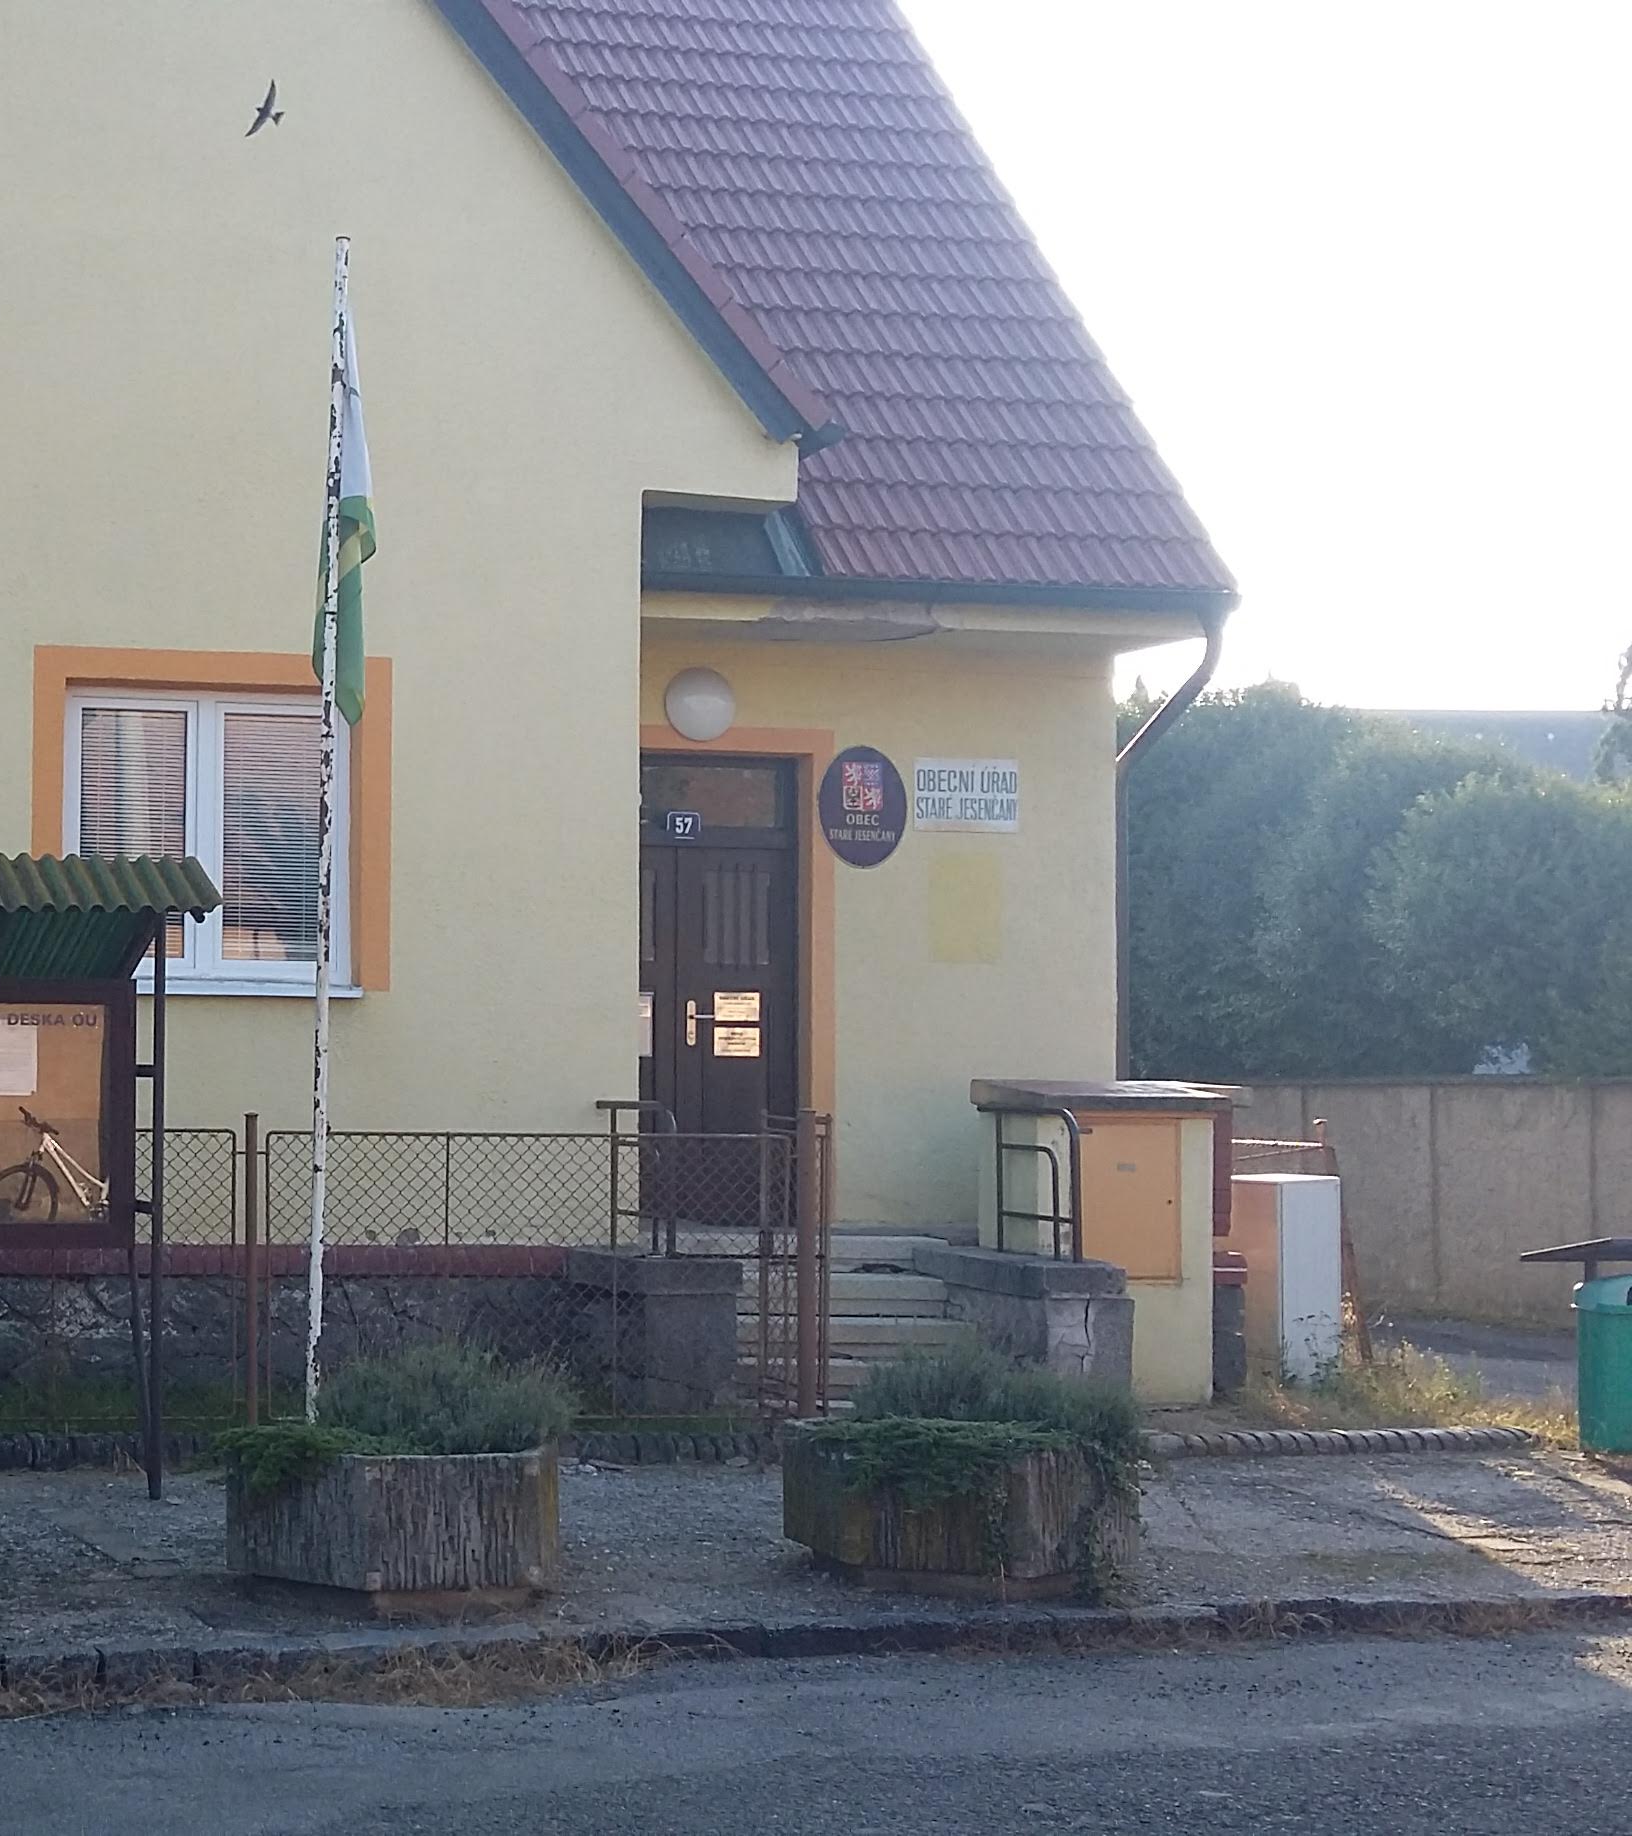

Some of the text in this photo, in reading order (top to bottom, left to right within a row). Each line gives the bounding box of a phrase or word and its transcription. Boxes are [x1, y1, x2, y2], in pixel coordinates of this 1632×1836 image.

[916, 764, 1017, 794] OBECNÍ ÚŘAD
[675, 817, 693, 834] 57
[846, 813, 879, 826] OBEC
[7, 1013, 65, 1026] DESKA
